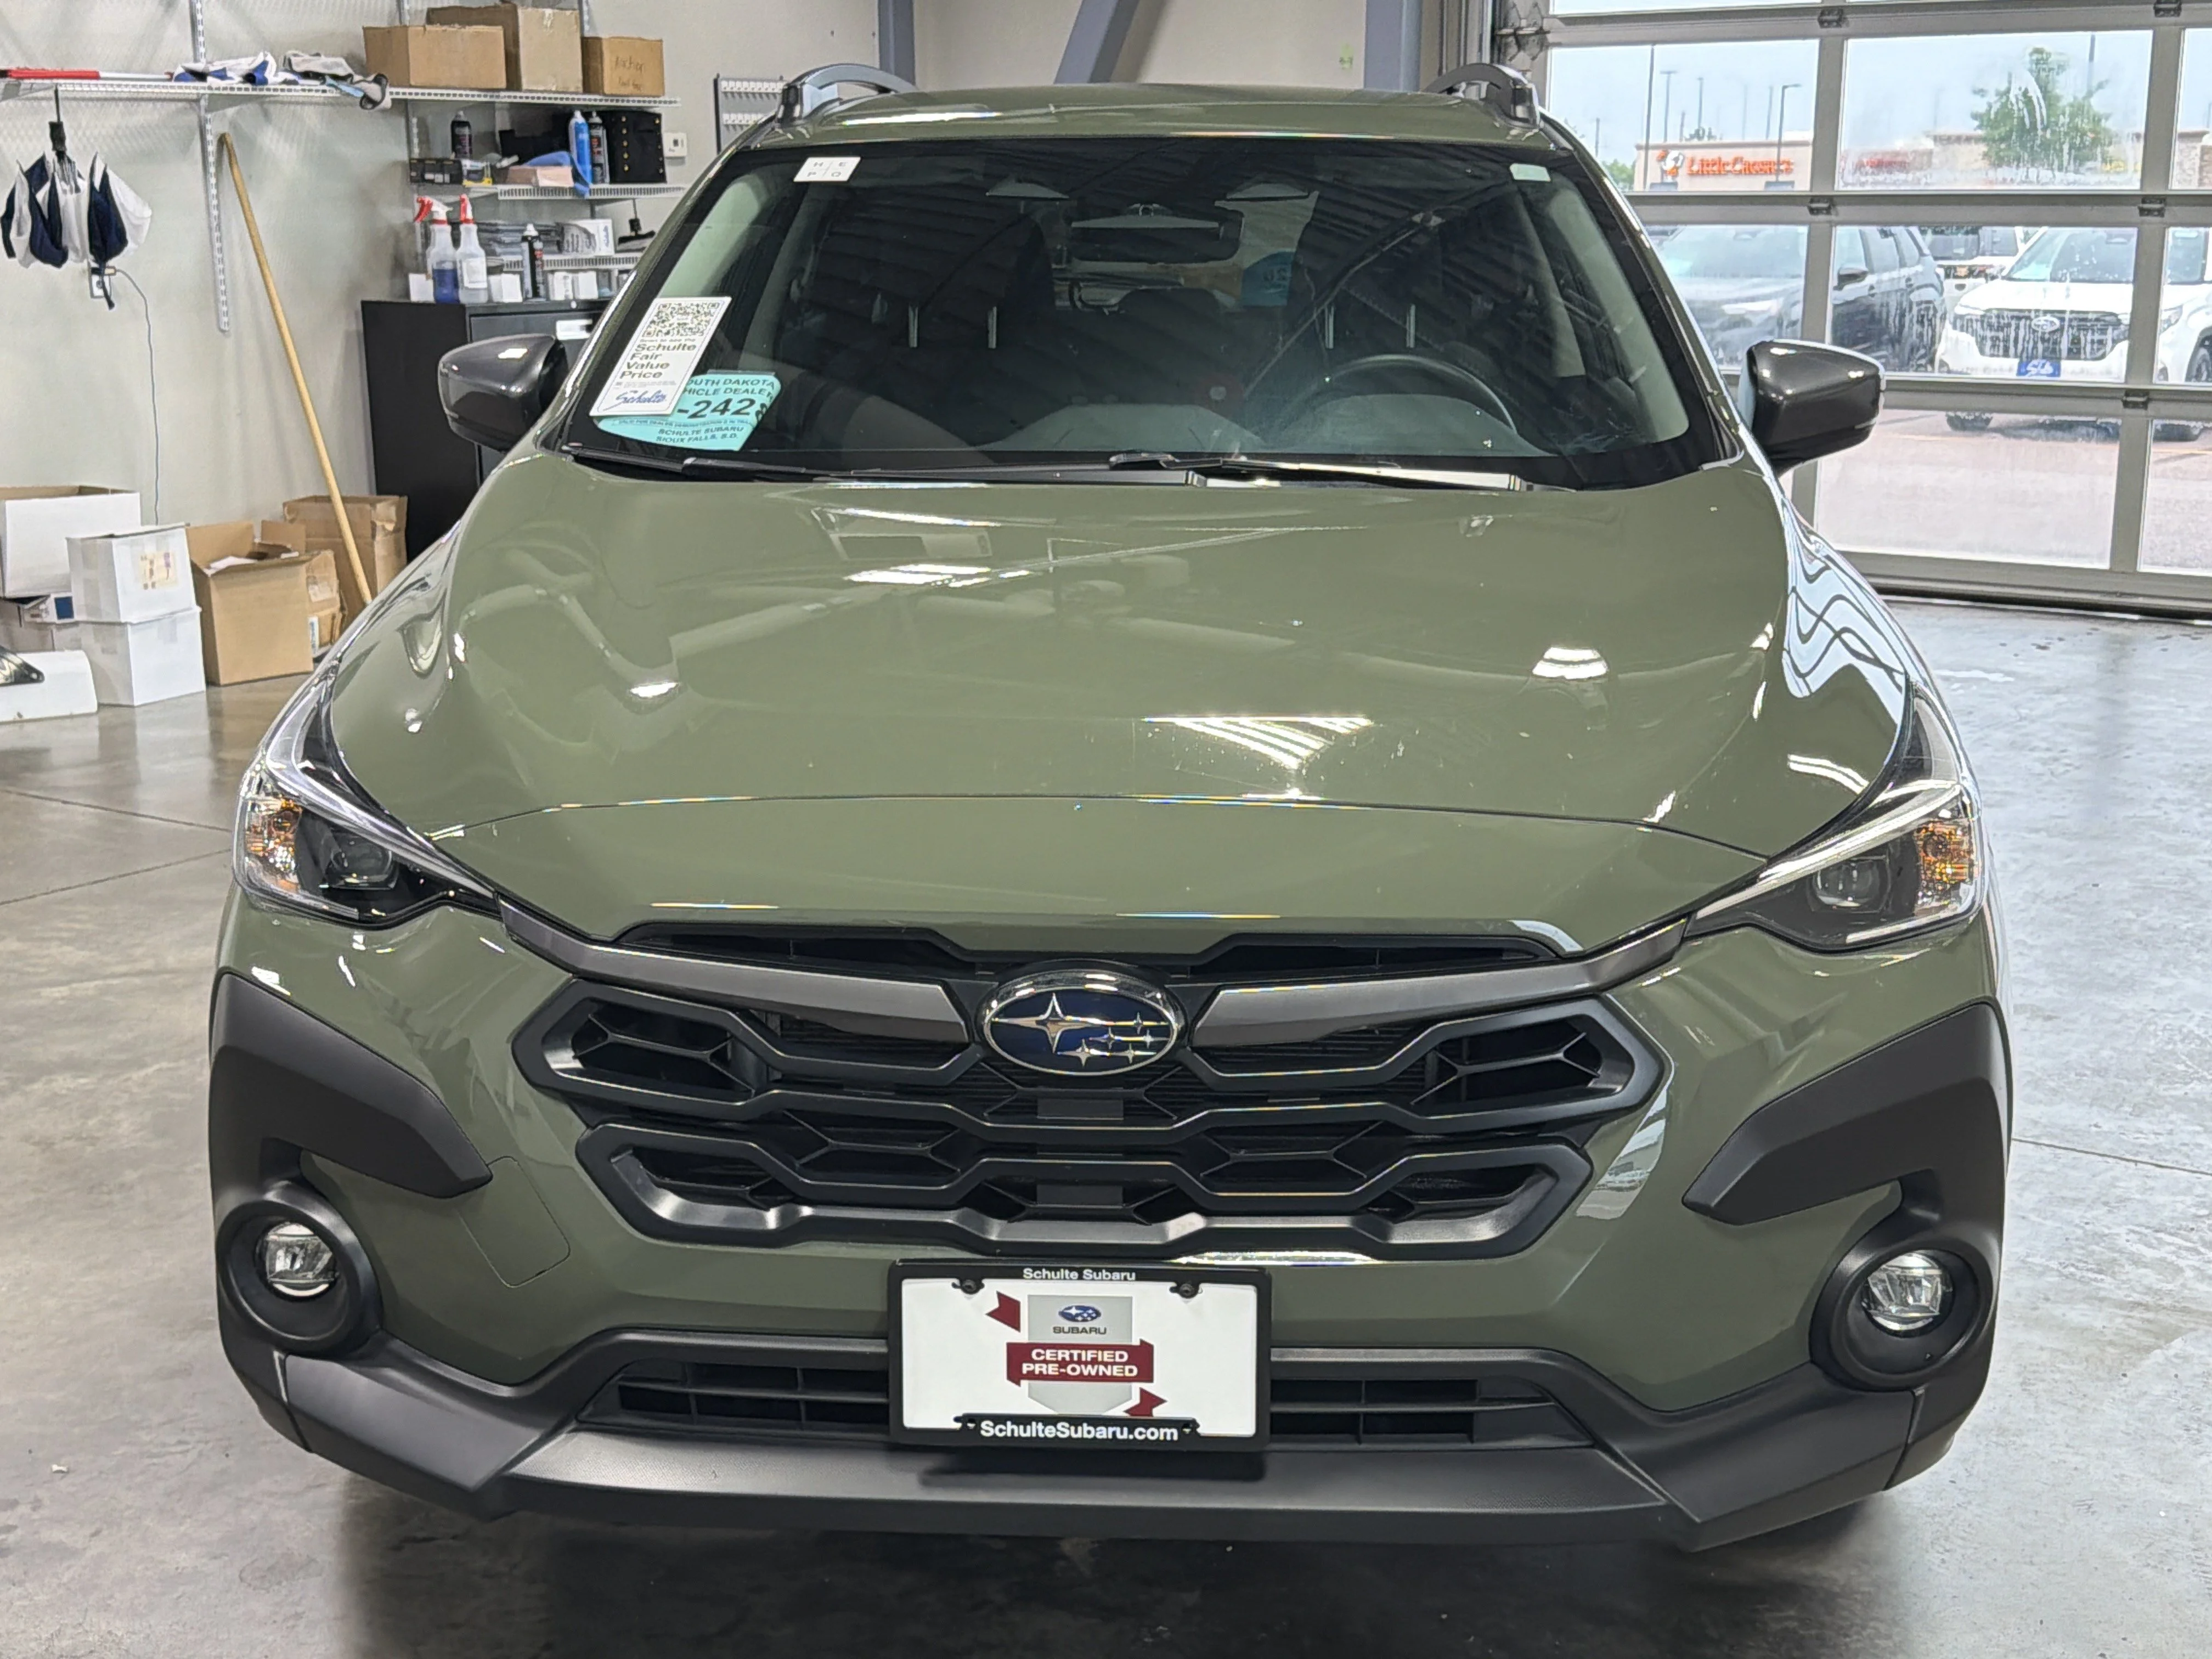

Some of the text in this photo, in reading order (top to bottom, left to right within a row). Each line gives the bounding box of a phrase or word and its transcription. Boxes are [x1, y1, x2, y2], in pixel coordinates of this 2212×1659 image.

[1686, 156, 1728, 176] Little
[635, 343, 696, 352] Schulte
[630, 352, 662, 360] Fair
[627, 361, 670, 370] Value
[619, 370, 663, 379] Price
[723, 378, 775, 390] DAKOTA
[1023, 1268, 1136, 1281] Schulte Subaru
[1052, 1326, 1107, 1335] SUBARU
[1031, 1348, 1129, 1362] CERTIFIED
[1022, 1363, 1139, 1377] PRE-OWNED
[980, 1420, 1178, 1441] SchulteSubaru.com
